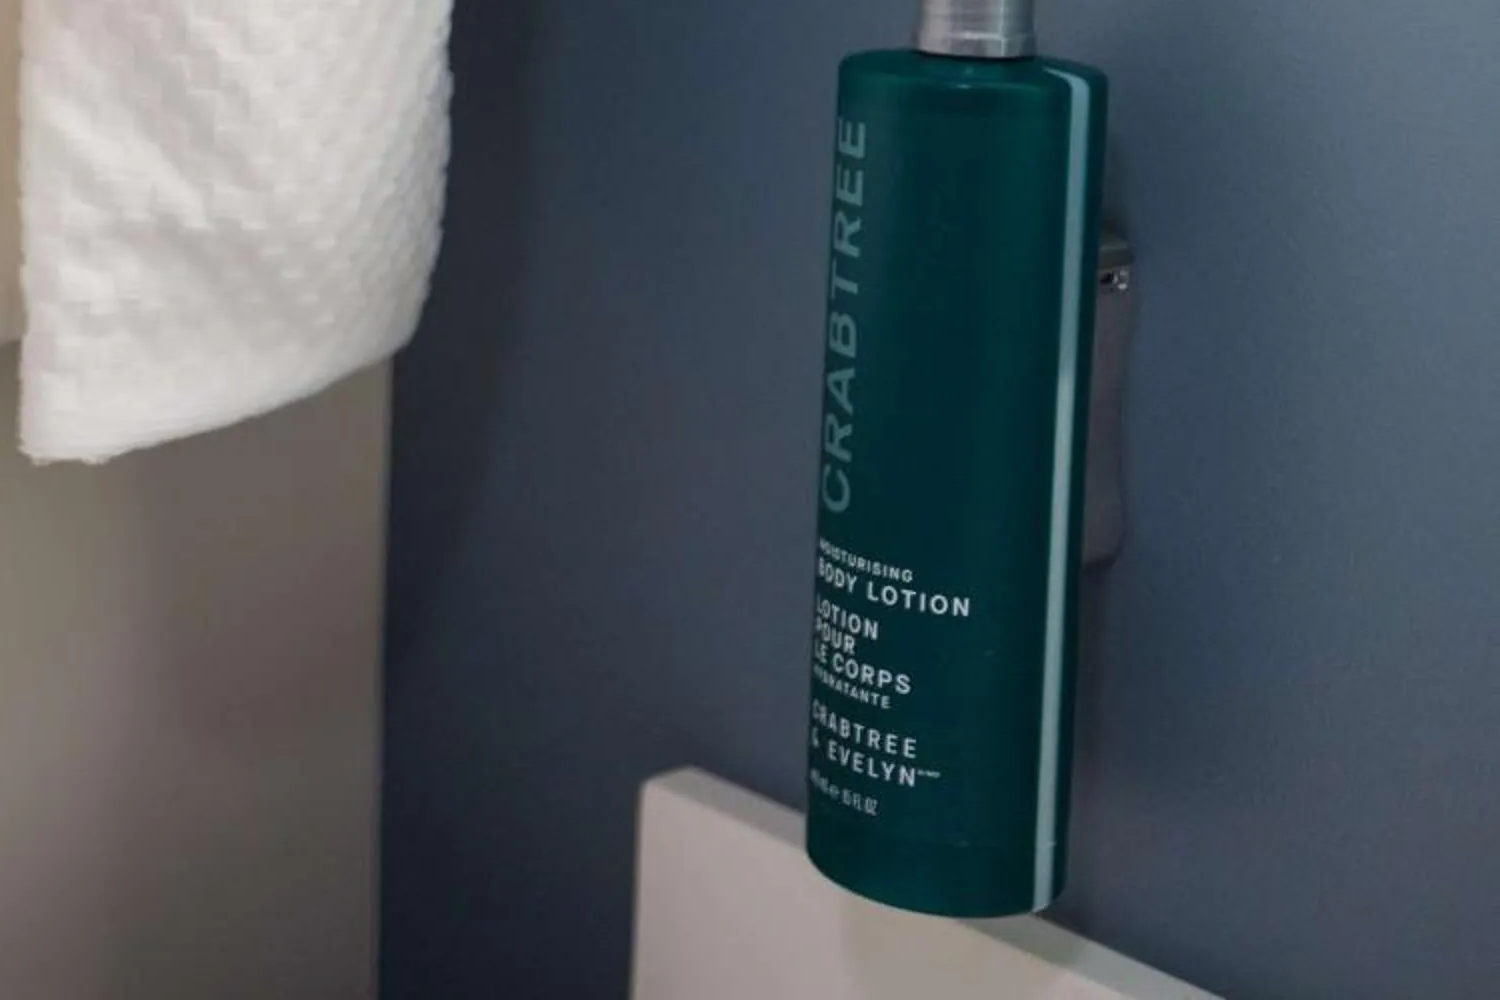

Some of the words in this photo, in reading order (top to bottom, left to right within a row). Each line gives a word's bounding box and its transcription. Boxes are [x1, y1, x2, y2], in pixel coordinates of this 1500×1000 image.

[822, 117, 867, 513] CRABTREE
[818, 556, 857, 593] BODY
[867, 580, 970, 617] LOTION
[815, 615, 856, 655] POUR
[816, 593, 879, 640] LOTION
[832, 653, 911, 695] CORPS
[812, 697, 917, 760] CRABTREE
[827, 739, 916, 788] EVELYN
